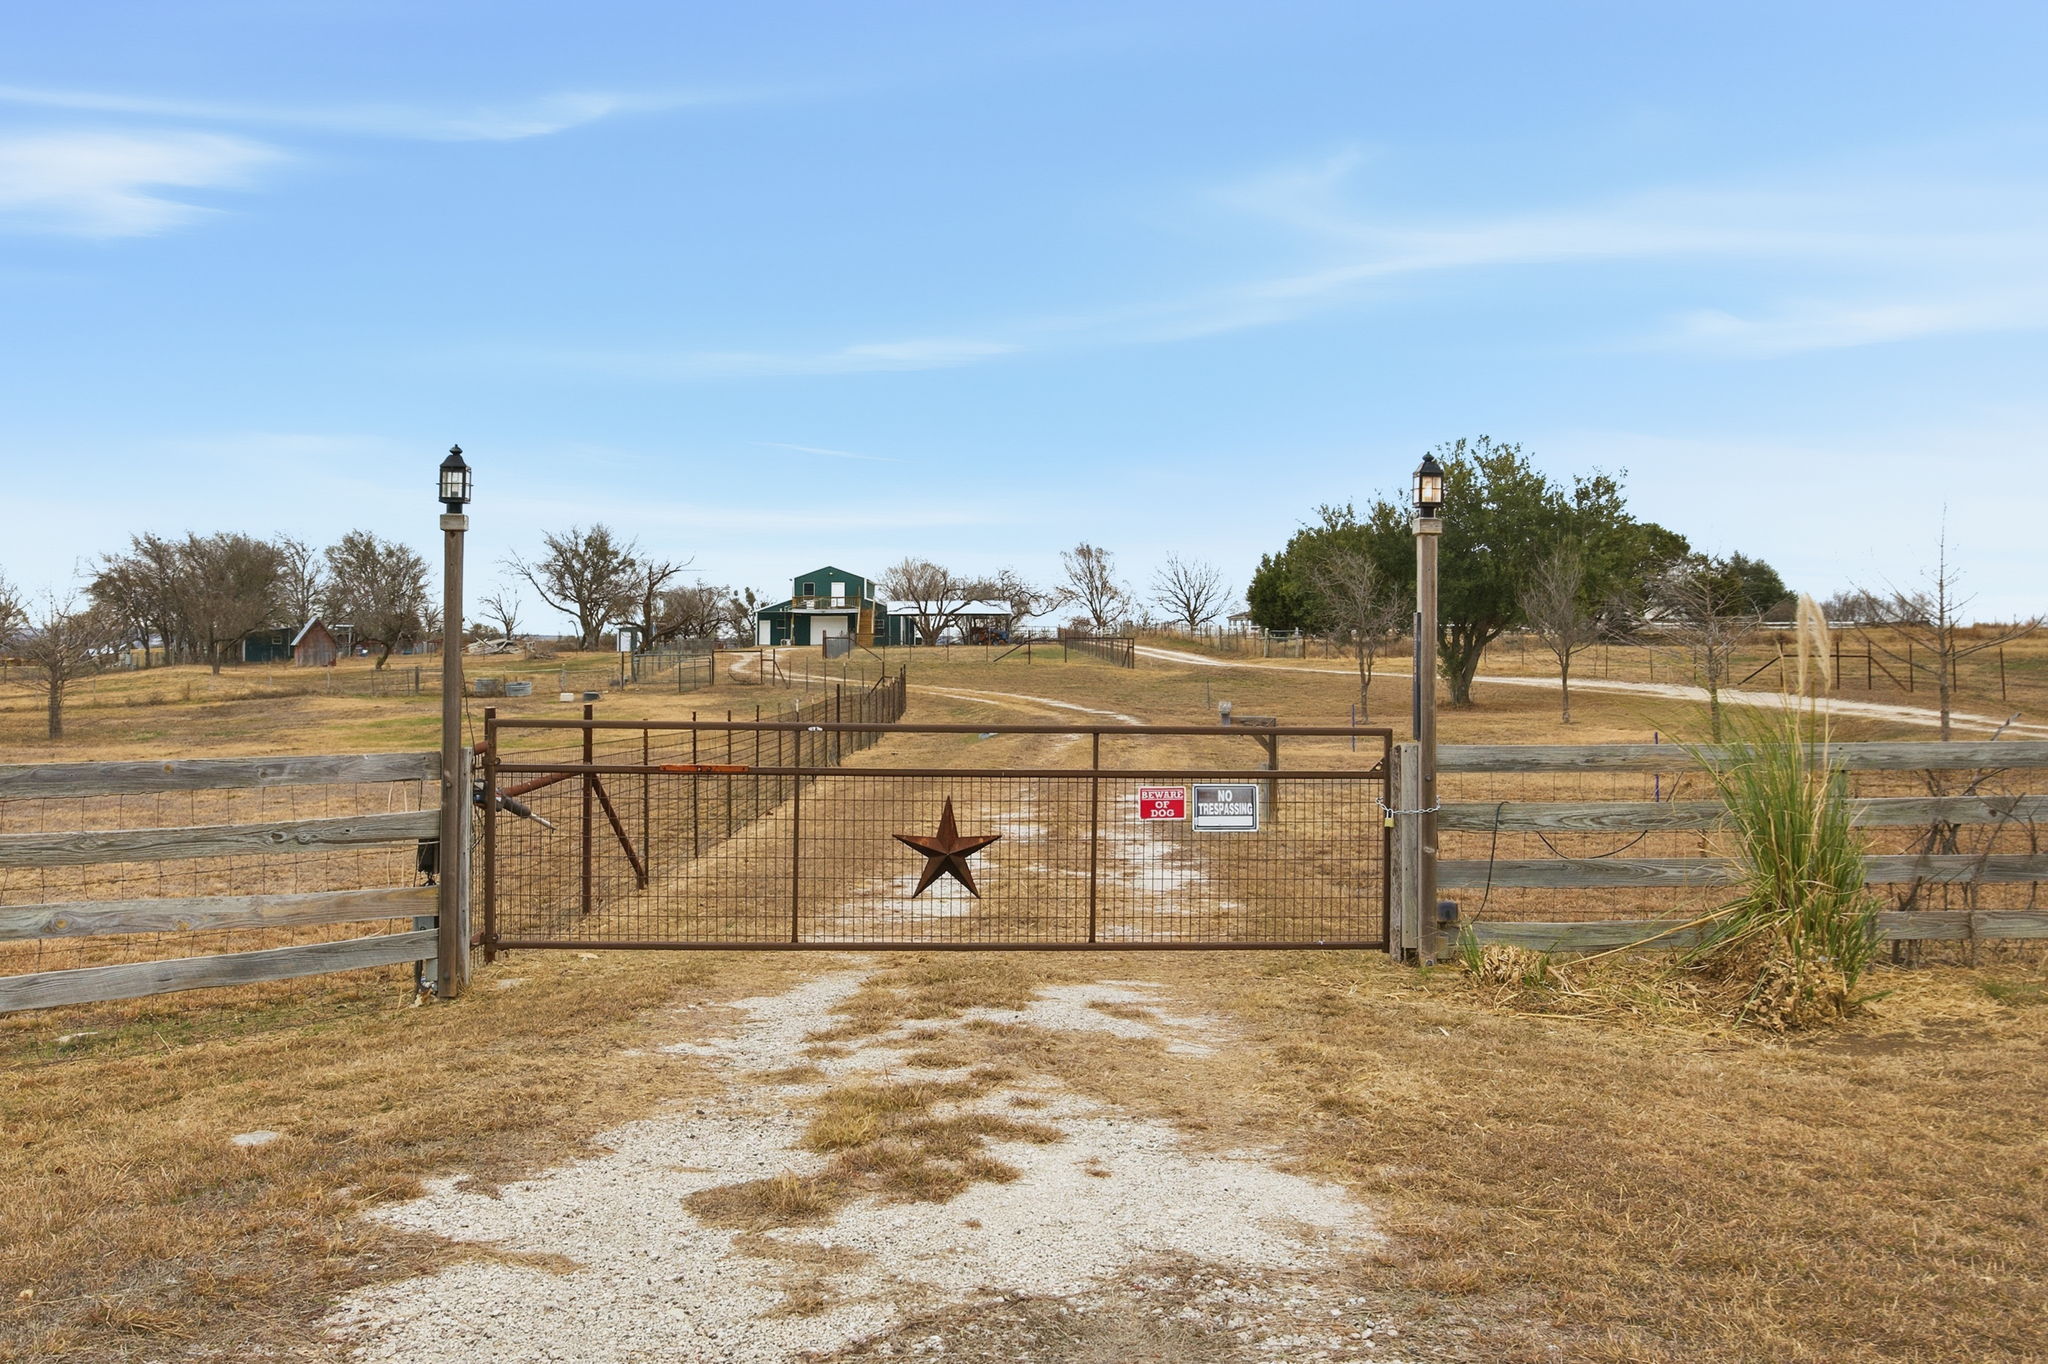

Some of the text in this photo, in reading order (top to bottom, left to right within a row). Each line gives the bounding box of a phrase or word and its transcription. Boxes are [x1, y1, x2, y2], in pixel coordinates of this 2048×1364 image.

[1141, 790, 1183, 800] BEWARE
[1217, 790, 1233, 802] NO
[1155, 801, 1170, 809] OF
[1198, 802, 1253, 815] TRESPASSING
[1150, 809, 1175, 817] DOG
